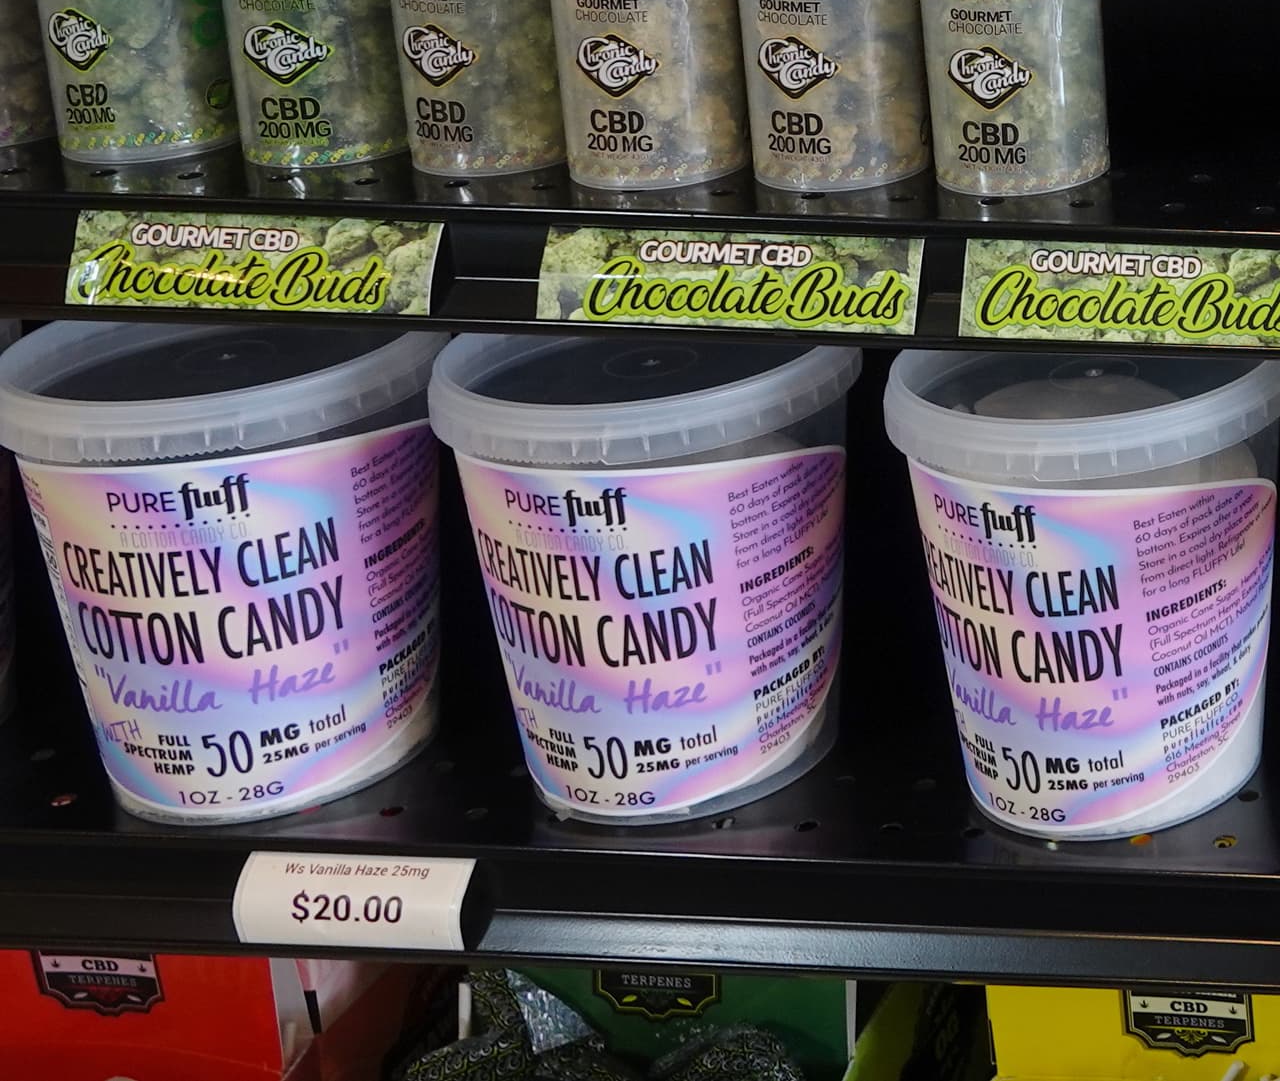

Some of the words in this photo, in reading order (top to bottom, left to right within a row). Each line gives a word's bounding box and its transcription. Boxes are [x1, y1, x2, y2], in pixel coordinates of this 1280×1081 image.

[948, 20, 1023, 36] CHOCOLATE
[950, 8, 1012, 22] GOURMET
[962, 121, 1020, 146] CBD
[958, 144, 991, 164] 200
[995, 147, 1026, 165] MG
[1030, 249, 1152, 277] GOURMET
[1151, 254, 1201, 279] CBD
[981, 270, 1178, 327] Chocolate
[106, 490, 177, 513] PURE
[63, 541, 222, 598] CREATIVELY
[237, 517, 340, 587] CLEAN
[1146, 579, 1227, 623] INGREDIENTS:
[78, 601, 205, 667] COTTON
[217, 575, 345, 659] CANDY
[1160, 689, 1222, 730] PACKAGED
[1224, 678, 1240, 694] BY:
[260, 722, 301, 748] MG
[309, 705, 347, 735] total
[202, 730, 253, 777] 50
[284, 862, 305, 874] Ws
[309, 863, 352, 876] Vanilla
[354, 864, 389, 877] Haze
[391, 865, 430, 880] 25mg
[291, 889, 403, 924] $20.00
[1154, 1015, 1225, 1028] TERPENES
[1170, 1001, 1209, 1014] CBD
